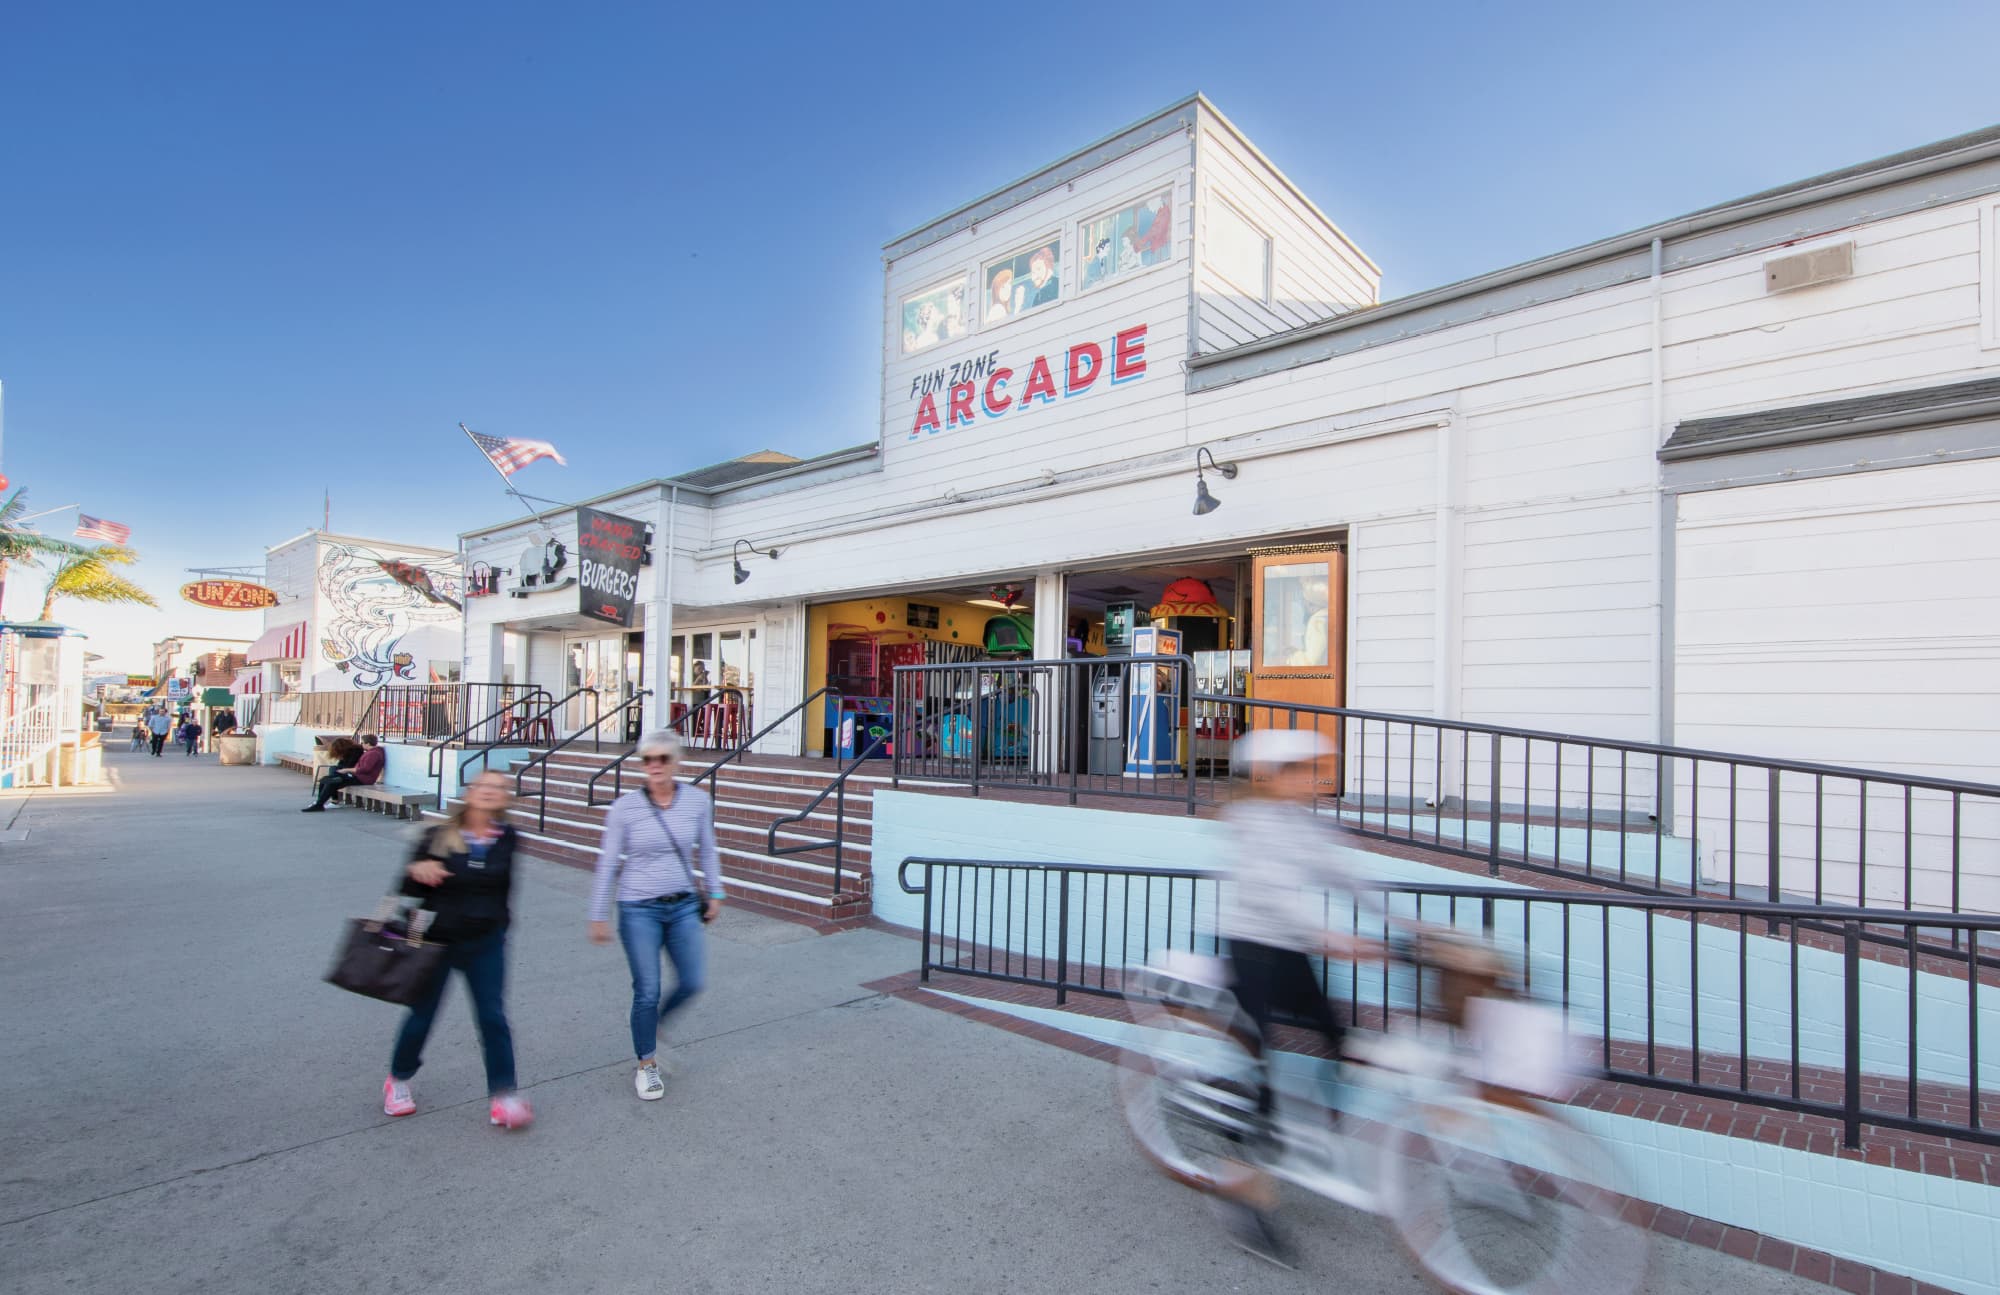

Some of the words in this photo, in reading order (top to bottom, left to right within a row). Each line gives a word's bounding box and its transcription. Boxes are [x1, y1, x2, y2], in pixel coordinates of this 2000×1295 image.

[909, 323, 1148, 440] ARCADE
[910, 368, 945, 400] FUN
[949, 350, 999, 387] ZONE
[579, 533, 641, 560] CRAFTED
[591, 517, 634, 539] HAND
[581, 559, 637, 601] BURGERS
